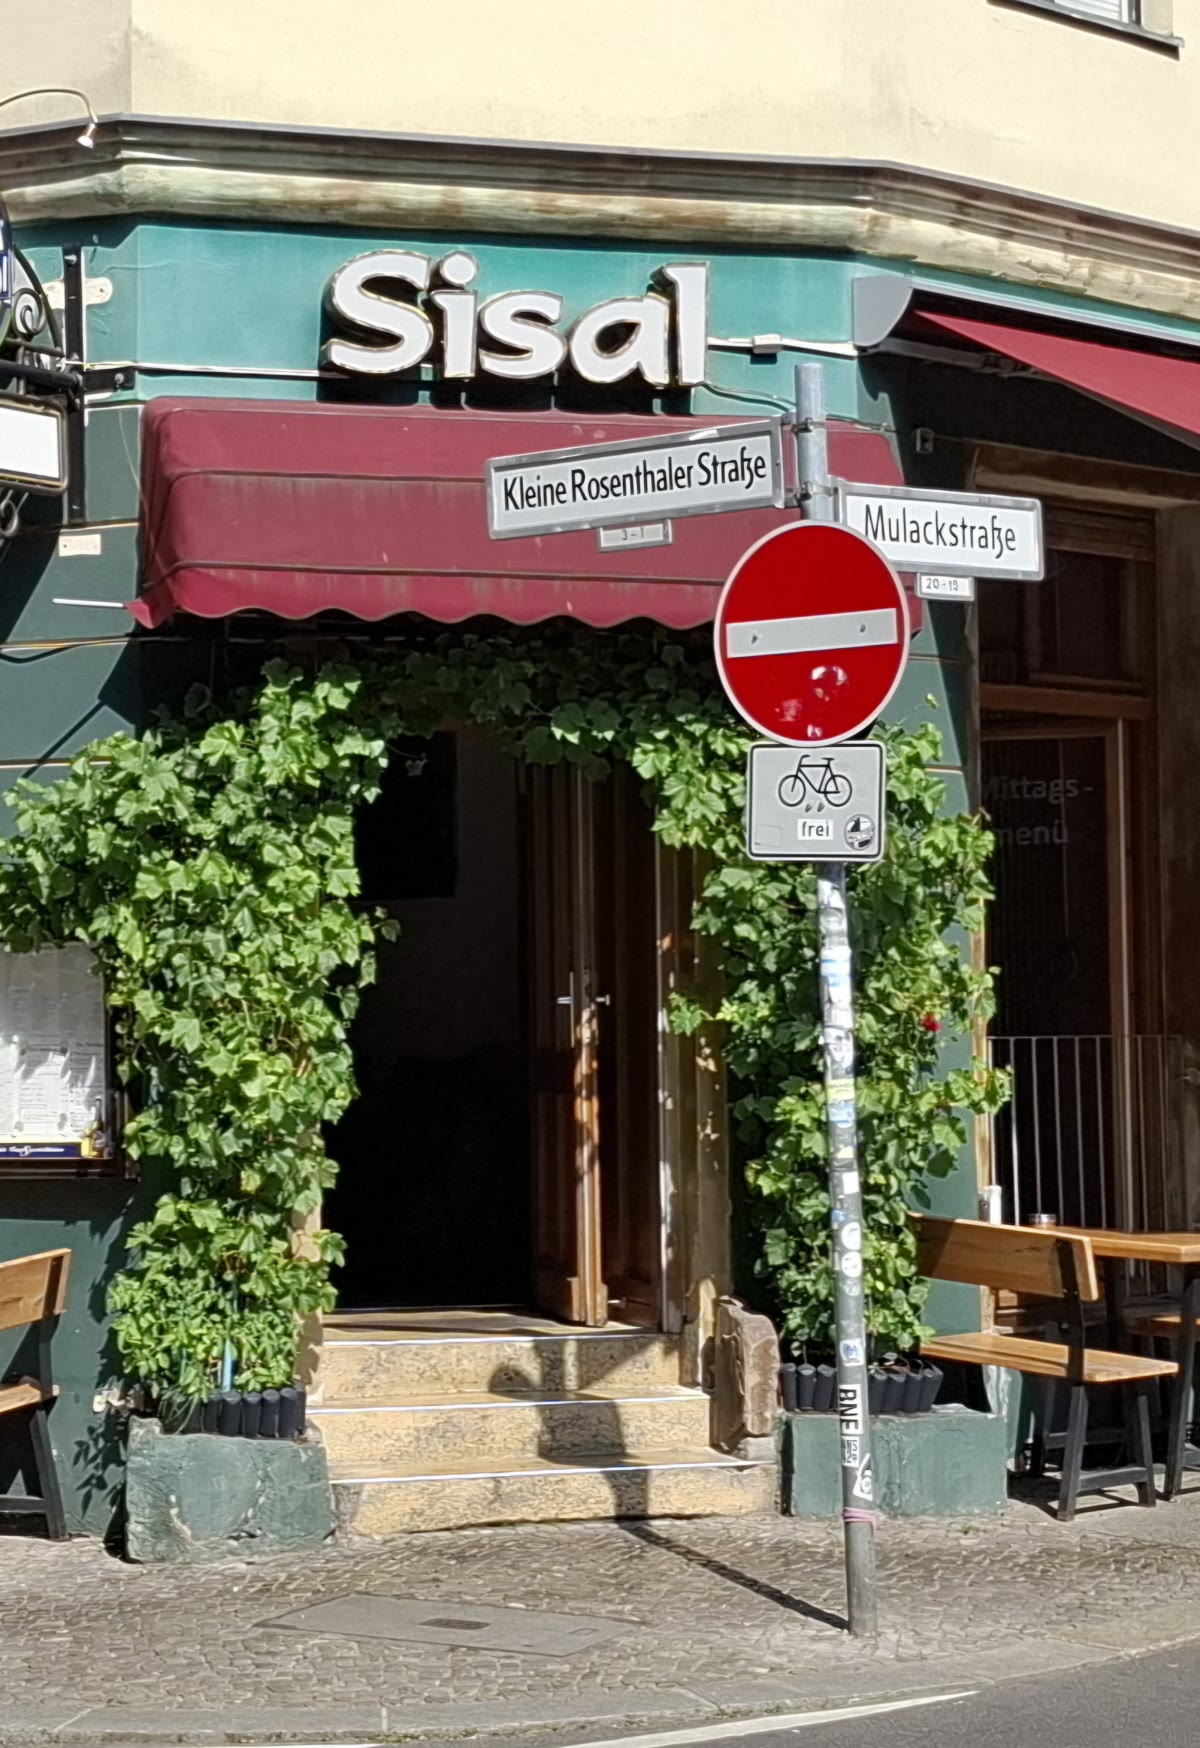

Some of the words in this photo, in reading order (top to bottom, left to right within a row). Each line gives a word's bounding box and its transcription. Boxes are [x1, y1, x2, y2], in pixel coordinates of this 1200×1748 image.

[322, 248, 710, 387] Sisal
[503, 474, 568, 511] Kleine
[571, 456, 693, 502] Rosenthaler
[697, 446, 767, 490] Straße
[864, 503, 1017, 560] Mulackstraße
[802, 820, 830, 837] frei
